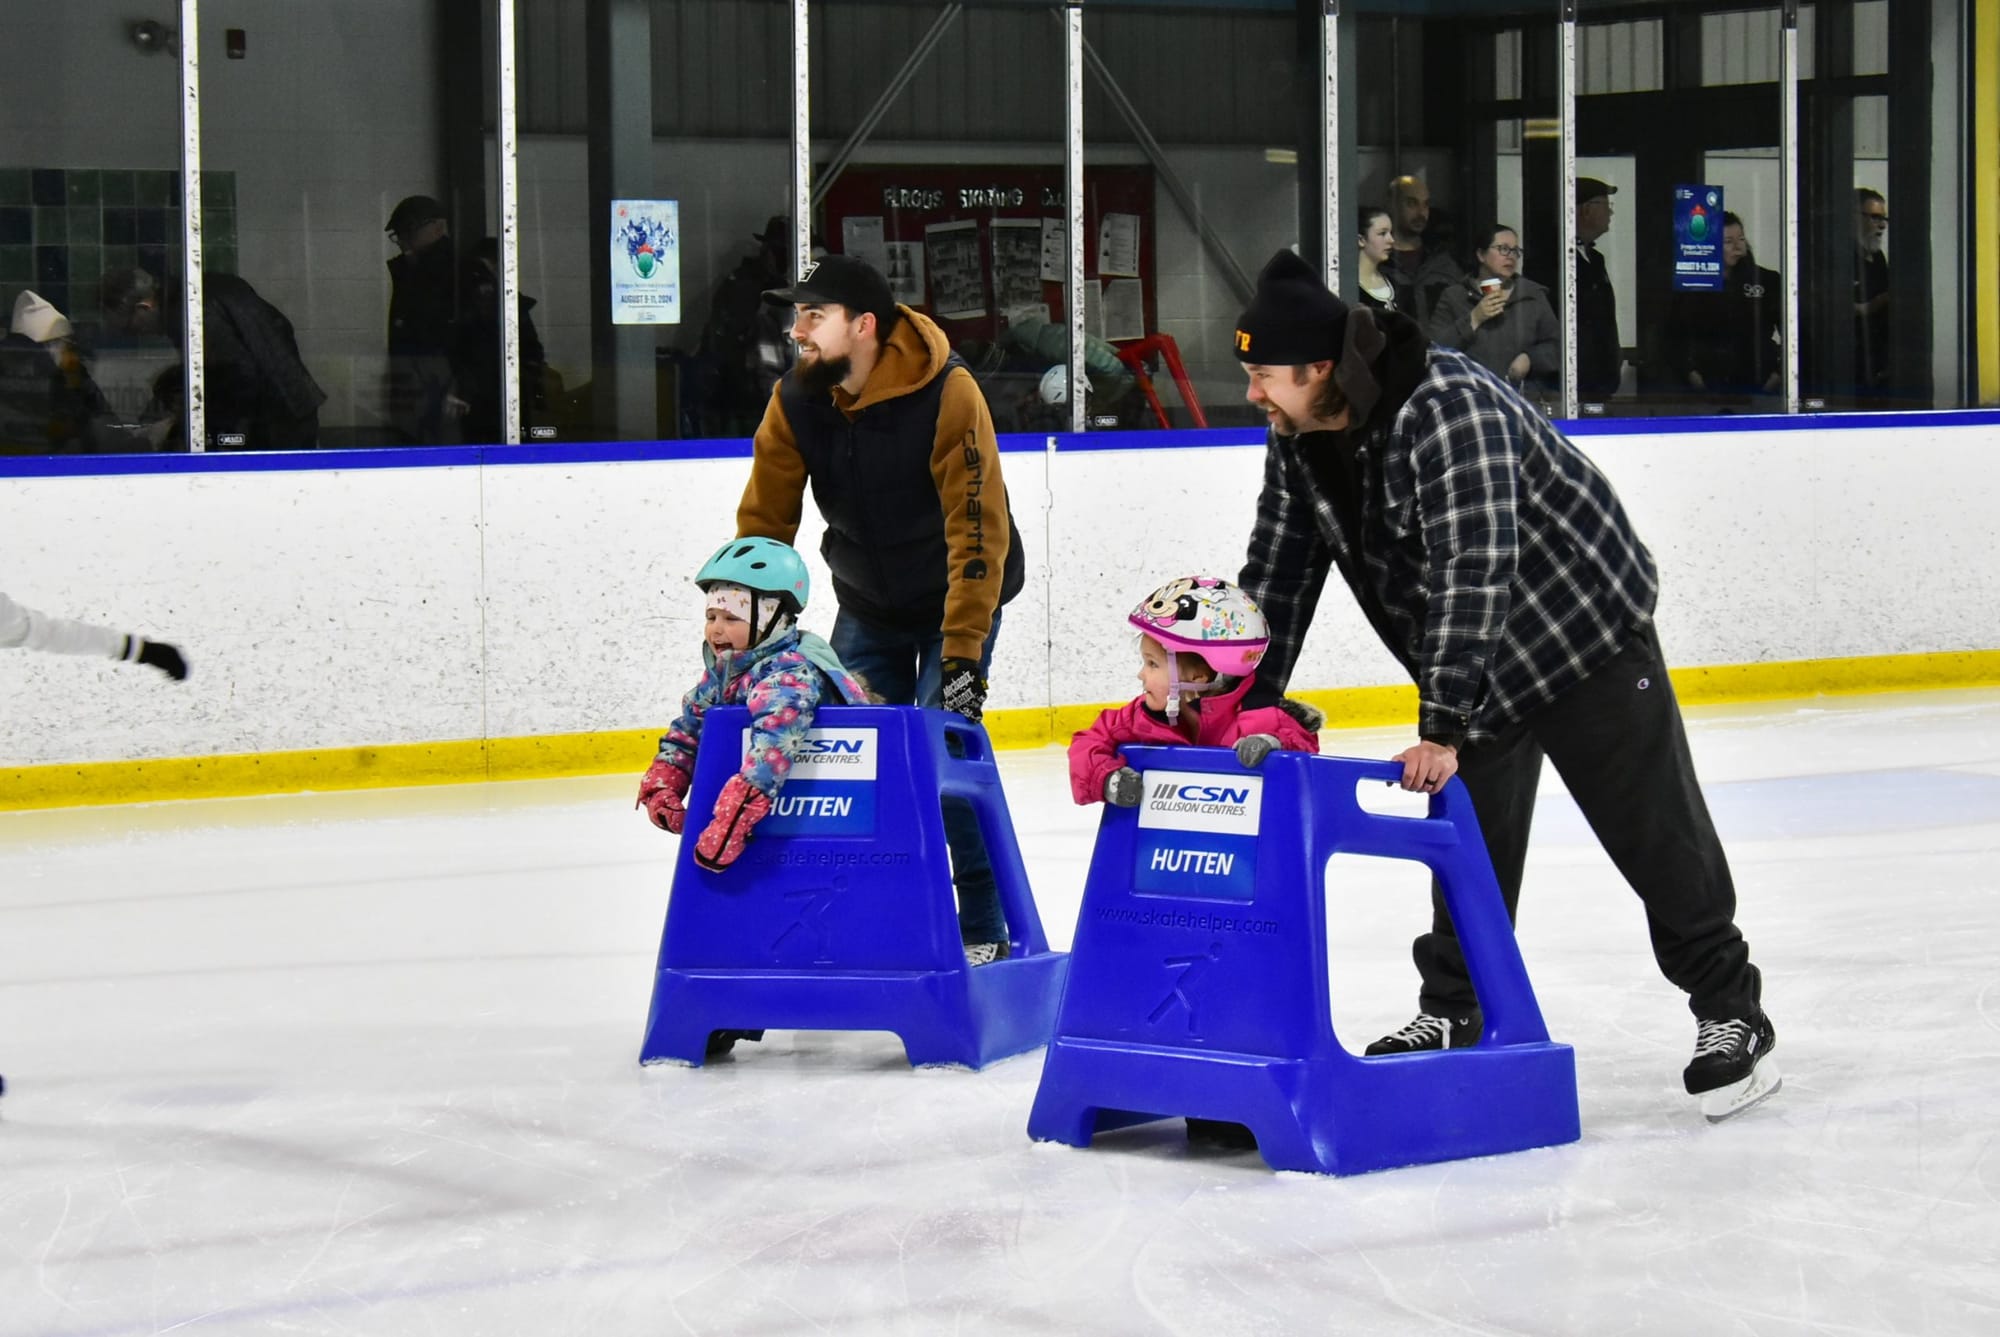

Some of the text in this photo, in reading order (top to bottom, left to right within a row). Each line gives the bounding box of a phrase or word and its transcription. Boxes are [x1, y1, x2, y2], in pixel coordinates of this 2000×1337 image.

[621, 295, 643, 304] AUGUST
[962, 429, 984, 554] carhartt
[1178, 785, 1250, 804] CSN
[1150, 800, 1200, 813] COLLISION
[1150, 848, 1234, 876] HUTTEN
[1096, 902, 1279, 935] www.skatehelper.com
